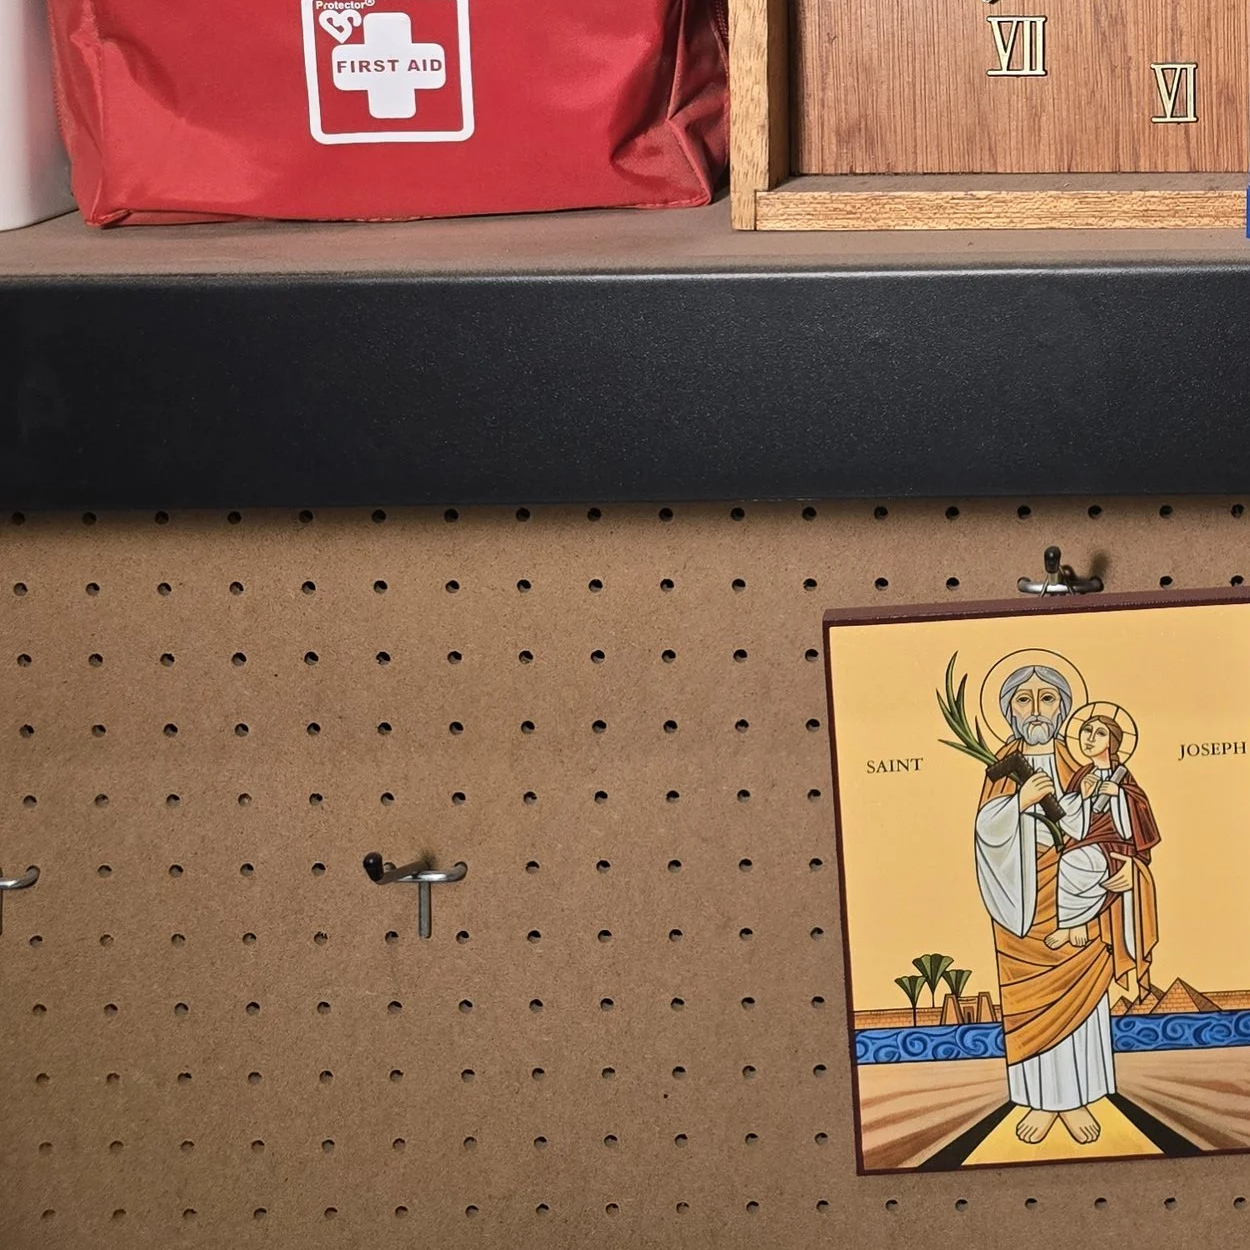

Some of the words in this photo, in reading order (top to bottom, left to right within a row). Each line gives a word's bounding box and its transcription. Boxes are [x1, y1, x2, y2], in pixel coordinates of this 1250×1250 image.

[986, 14, 1048, 78] VII
[337, 60, 399, 73] FIRST
[408, 59, 442, 71] AID
[1149, 62, 1199, 125] VI
[1177, 741, 1247, 762] JOSEPH
[866, 757, 924, 774] SAINT
